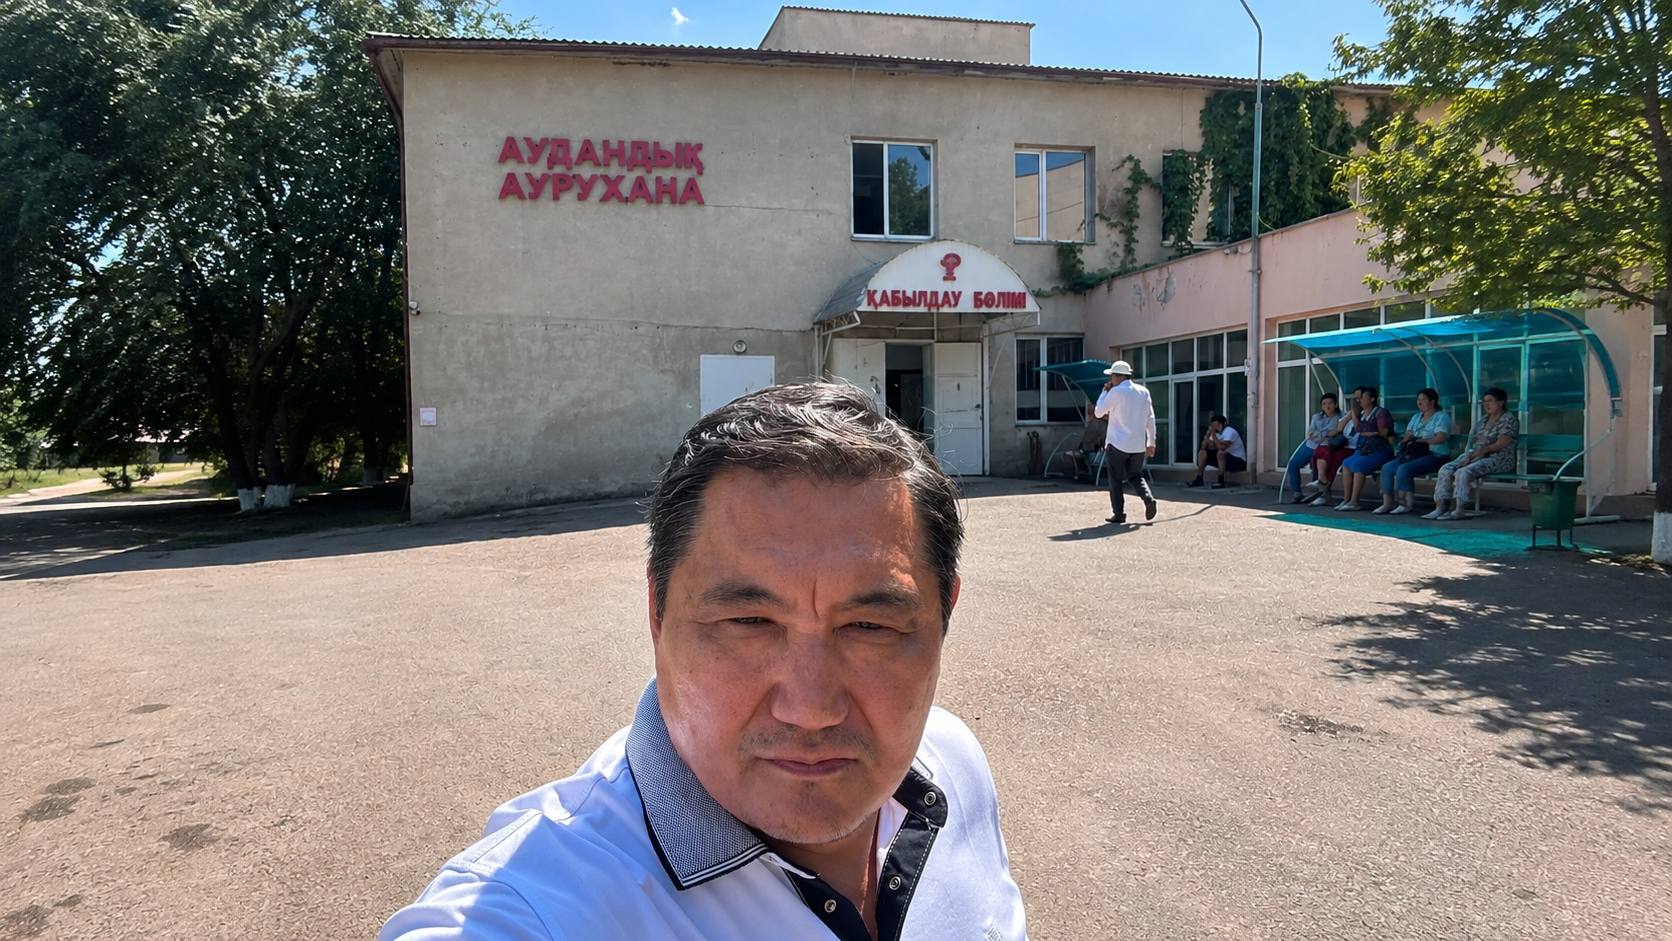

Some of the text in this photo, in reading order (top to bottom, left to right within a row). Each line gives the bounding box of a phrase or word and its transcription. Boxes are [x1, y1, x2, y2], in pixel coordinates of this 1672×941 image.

[498, 136, 704, 176] АУДАНДЫҚ
[498, 172, 705, 205] АУРУХАНА
[866, 289, 962, 311] ҚАБЫЛДАУ
